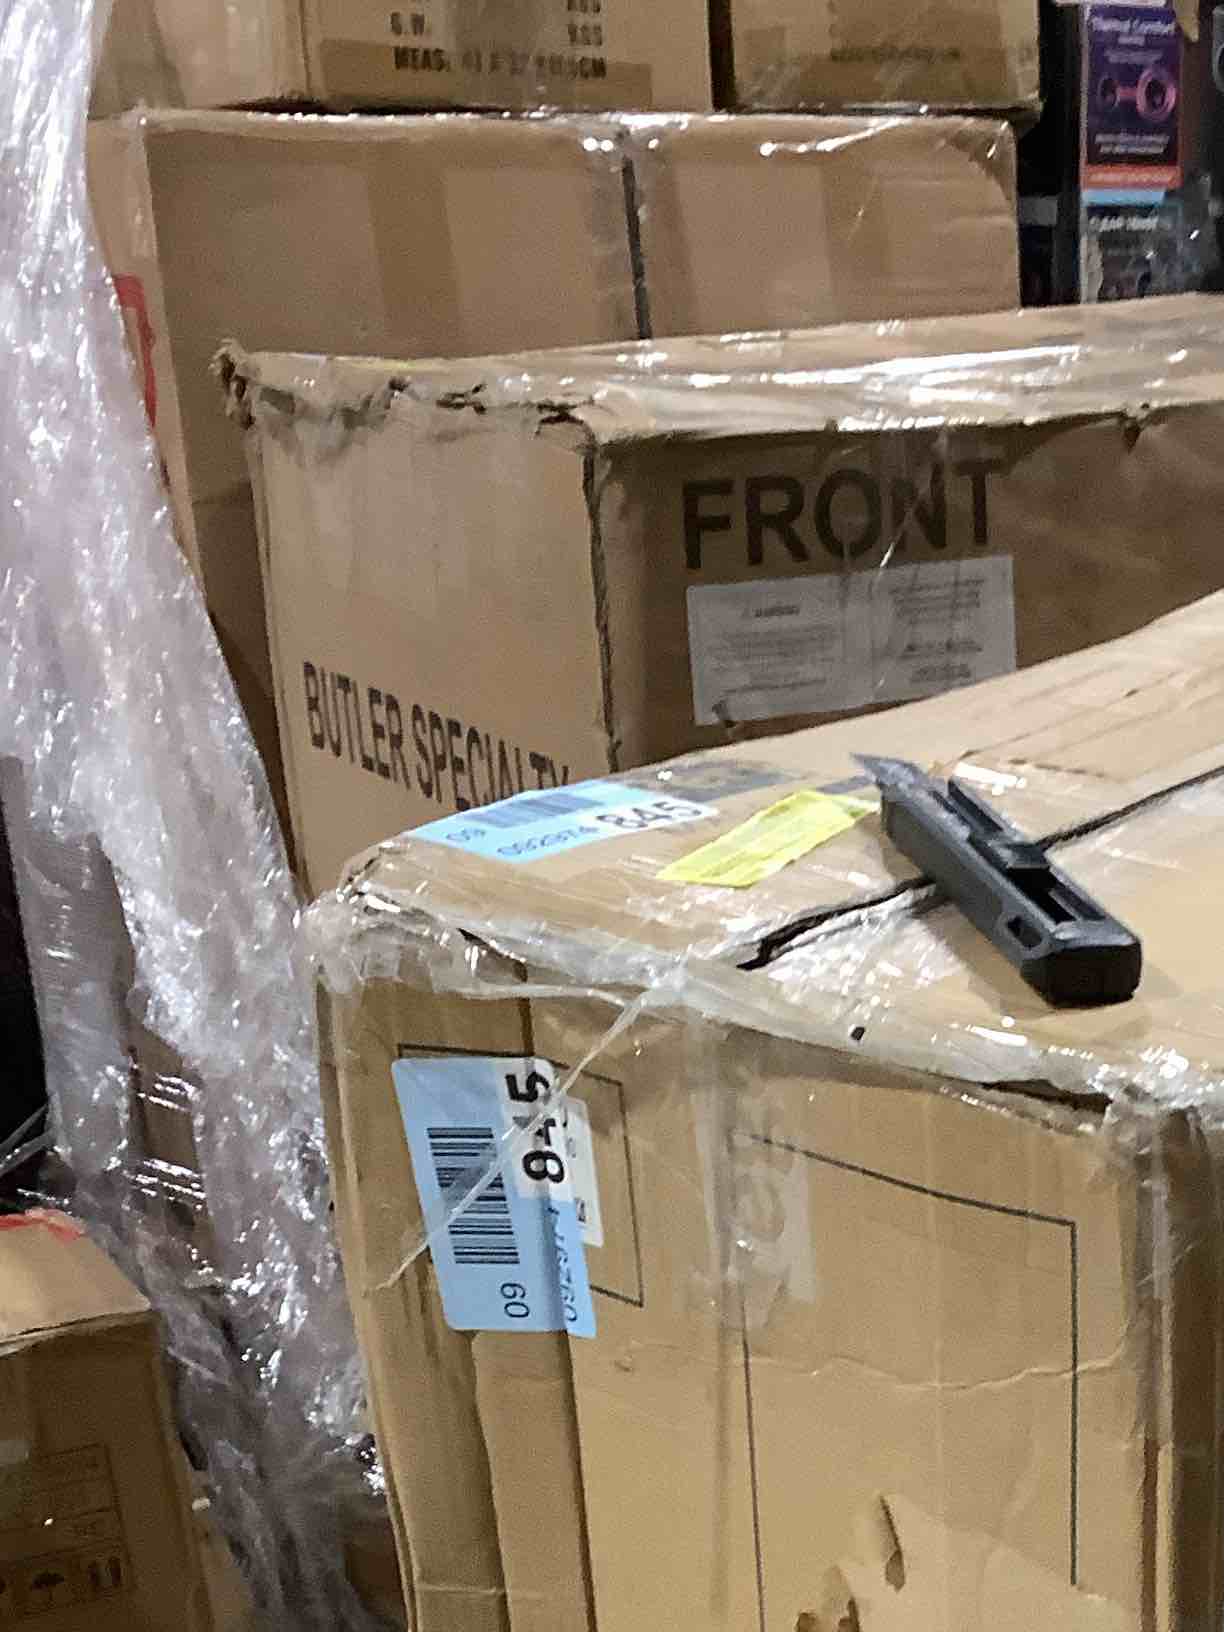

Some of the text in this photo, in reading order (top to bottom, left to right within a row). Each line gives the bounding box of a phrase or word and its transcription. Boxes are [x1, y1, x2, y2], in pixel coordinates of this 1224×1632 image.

[682, 457, 1008, 569] FRONT
[303, 660, 411, 791] BUTLER
[499, 1281, 531, 1319] 09
